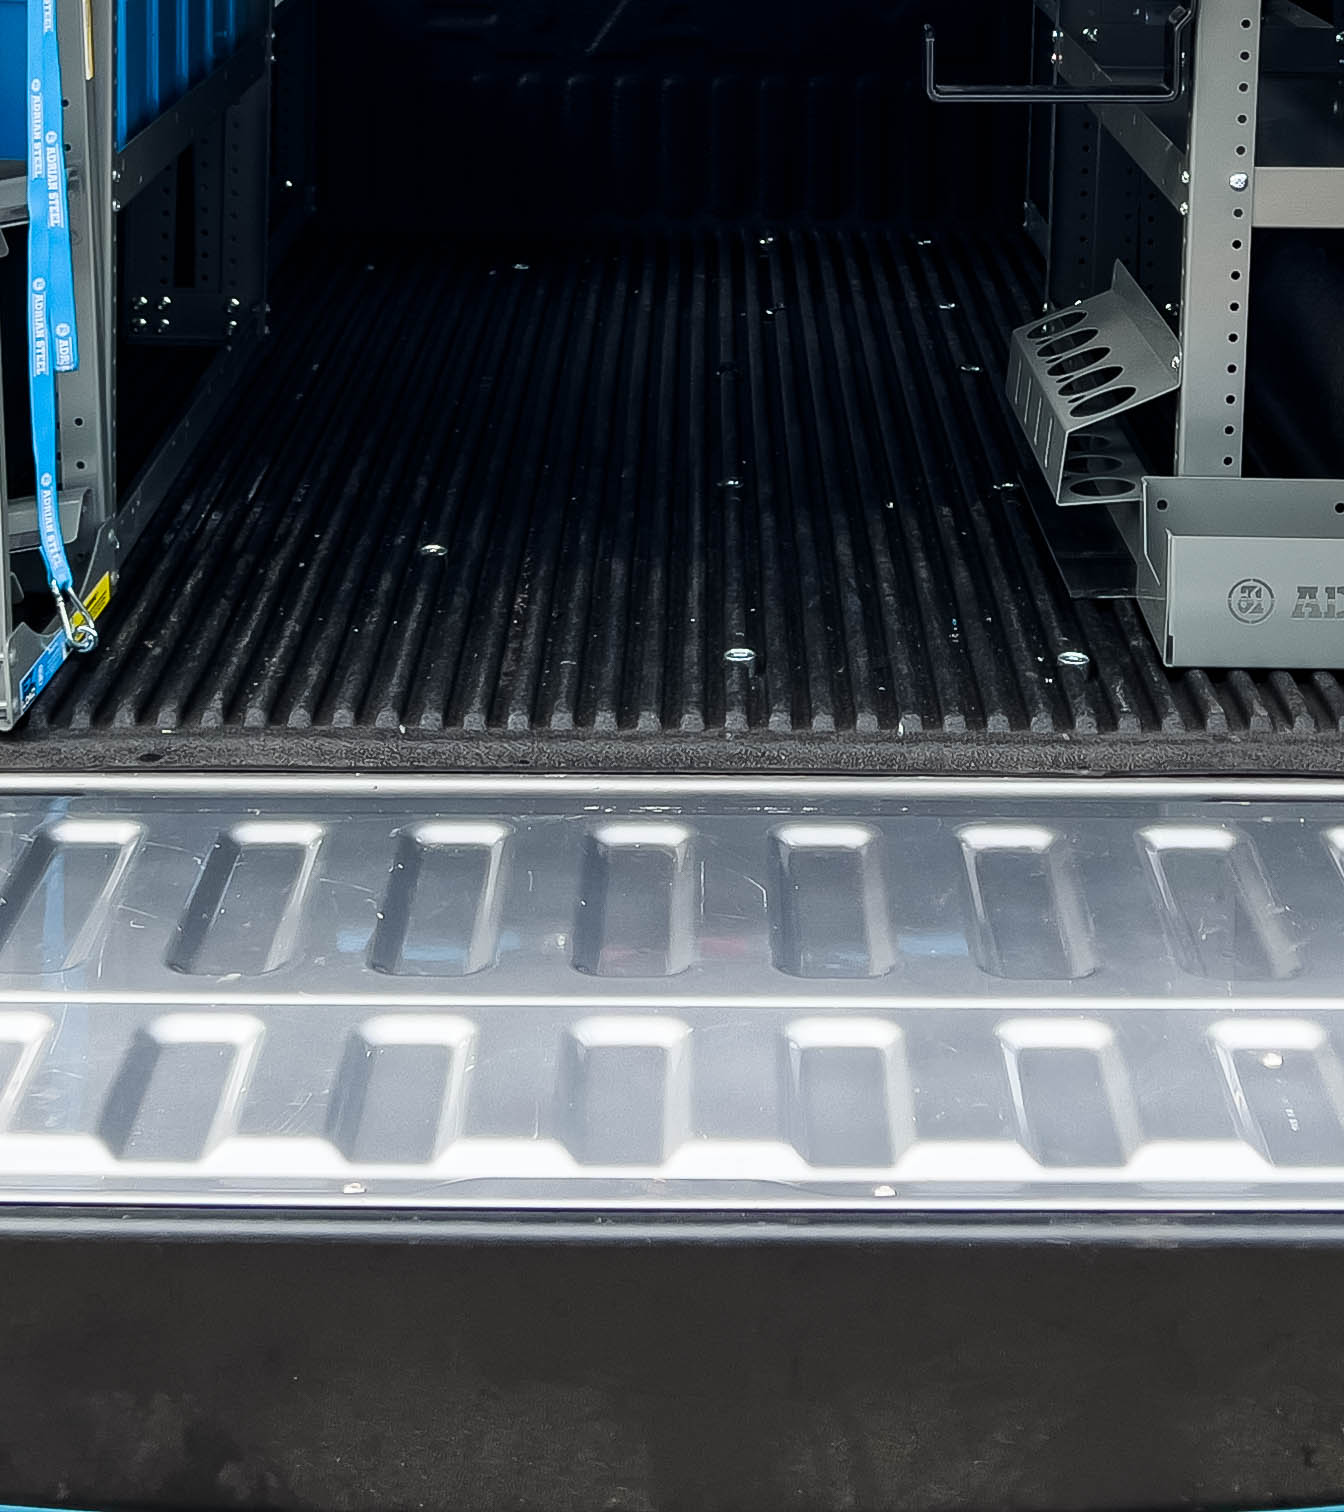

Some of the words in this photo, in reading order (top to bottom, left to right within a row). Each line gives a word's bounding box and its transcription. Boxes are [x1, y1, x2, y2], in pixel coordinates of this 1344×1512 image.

[32, 94, 41, 140] ADRIAN
[46, 147, 58, 190] ADRIAN
[35, 293, 45, 338] ADRIAN
[43, 490, 54, 533] ADRIAN
